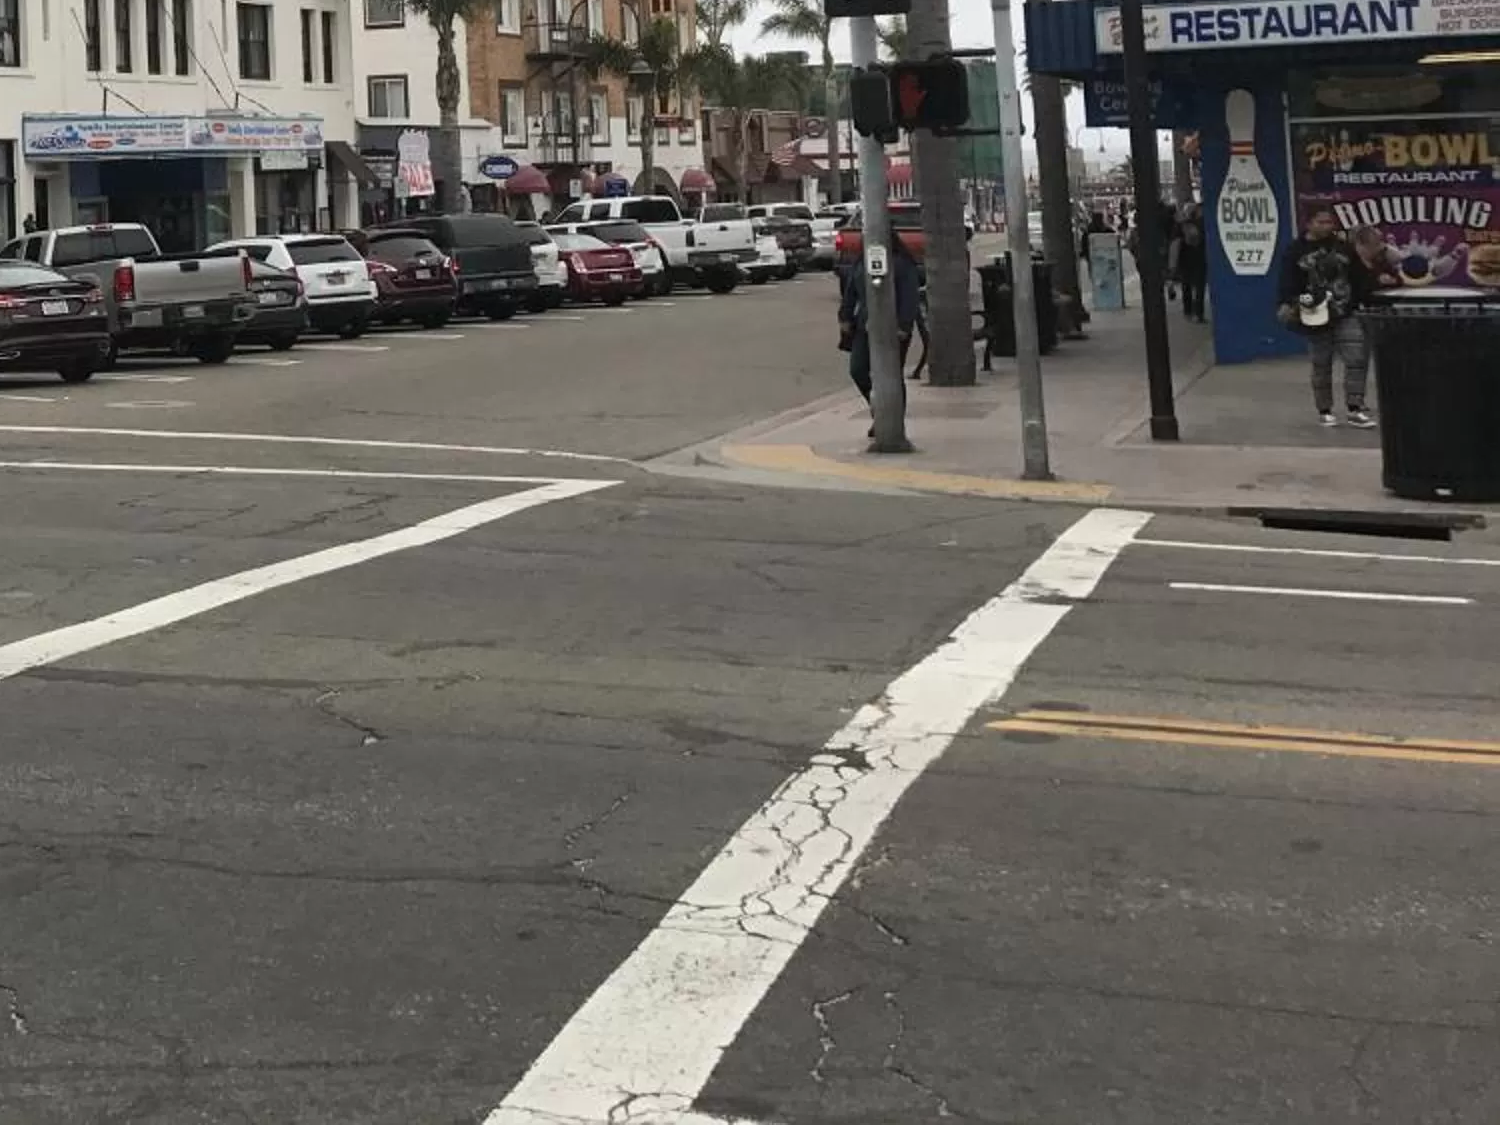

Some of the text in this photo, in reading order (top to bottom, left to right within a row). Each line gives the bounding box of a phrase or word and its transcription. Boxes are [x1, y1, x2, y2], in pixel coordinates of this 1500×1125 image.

[1469, 18, 1500, 29] DOG
[1383, 133, 1500, 167] BOWL
[1333, 170, 1480, 185] RESTAURANT
[1222, 196, 1276, 224] BOWL
[1333, 196, 1492, 231] BOWLING
[1235, 250, 1264, 262] 277
